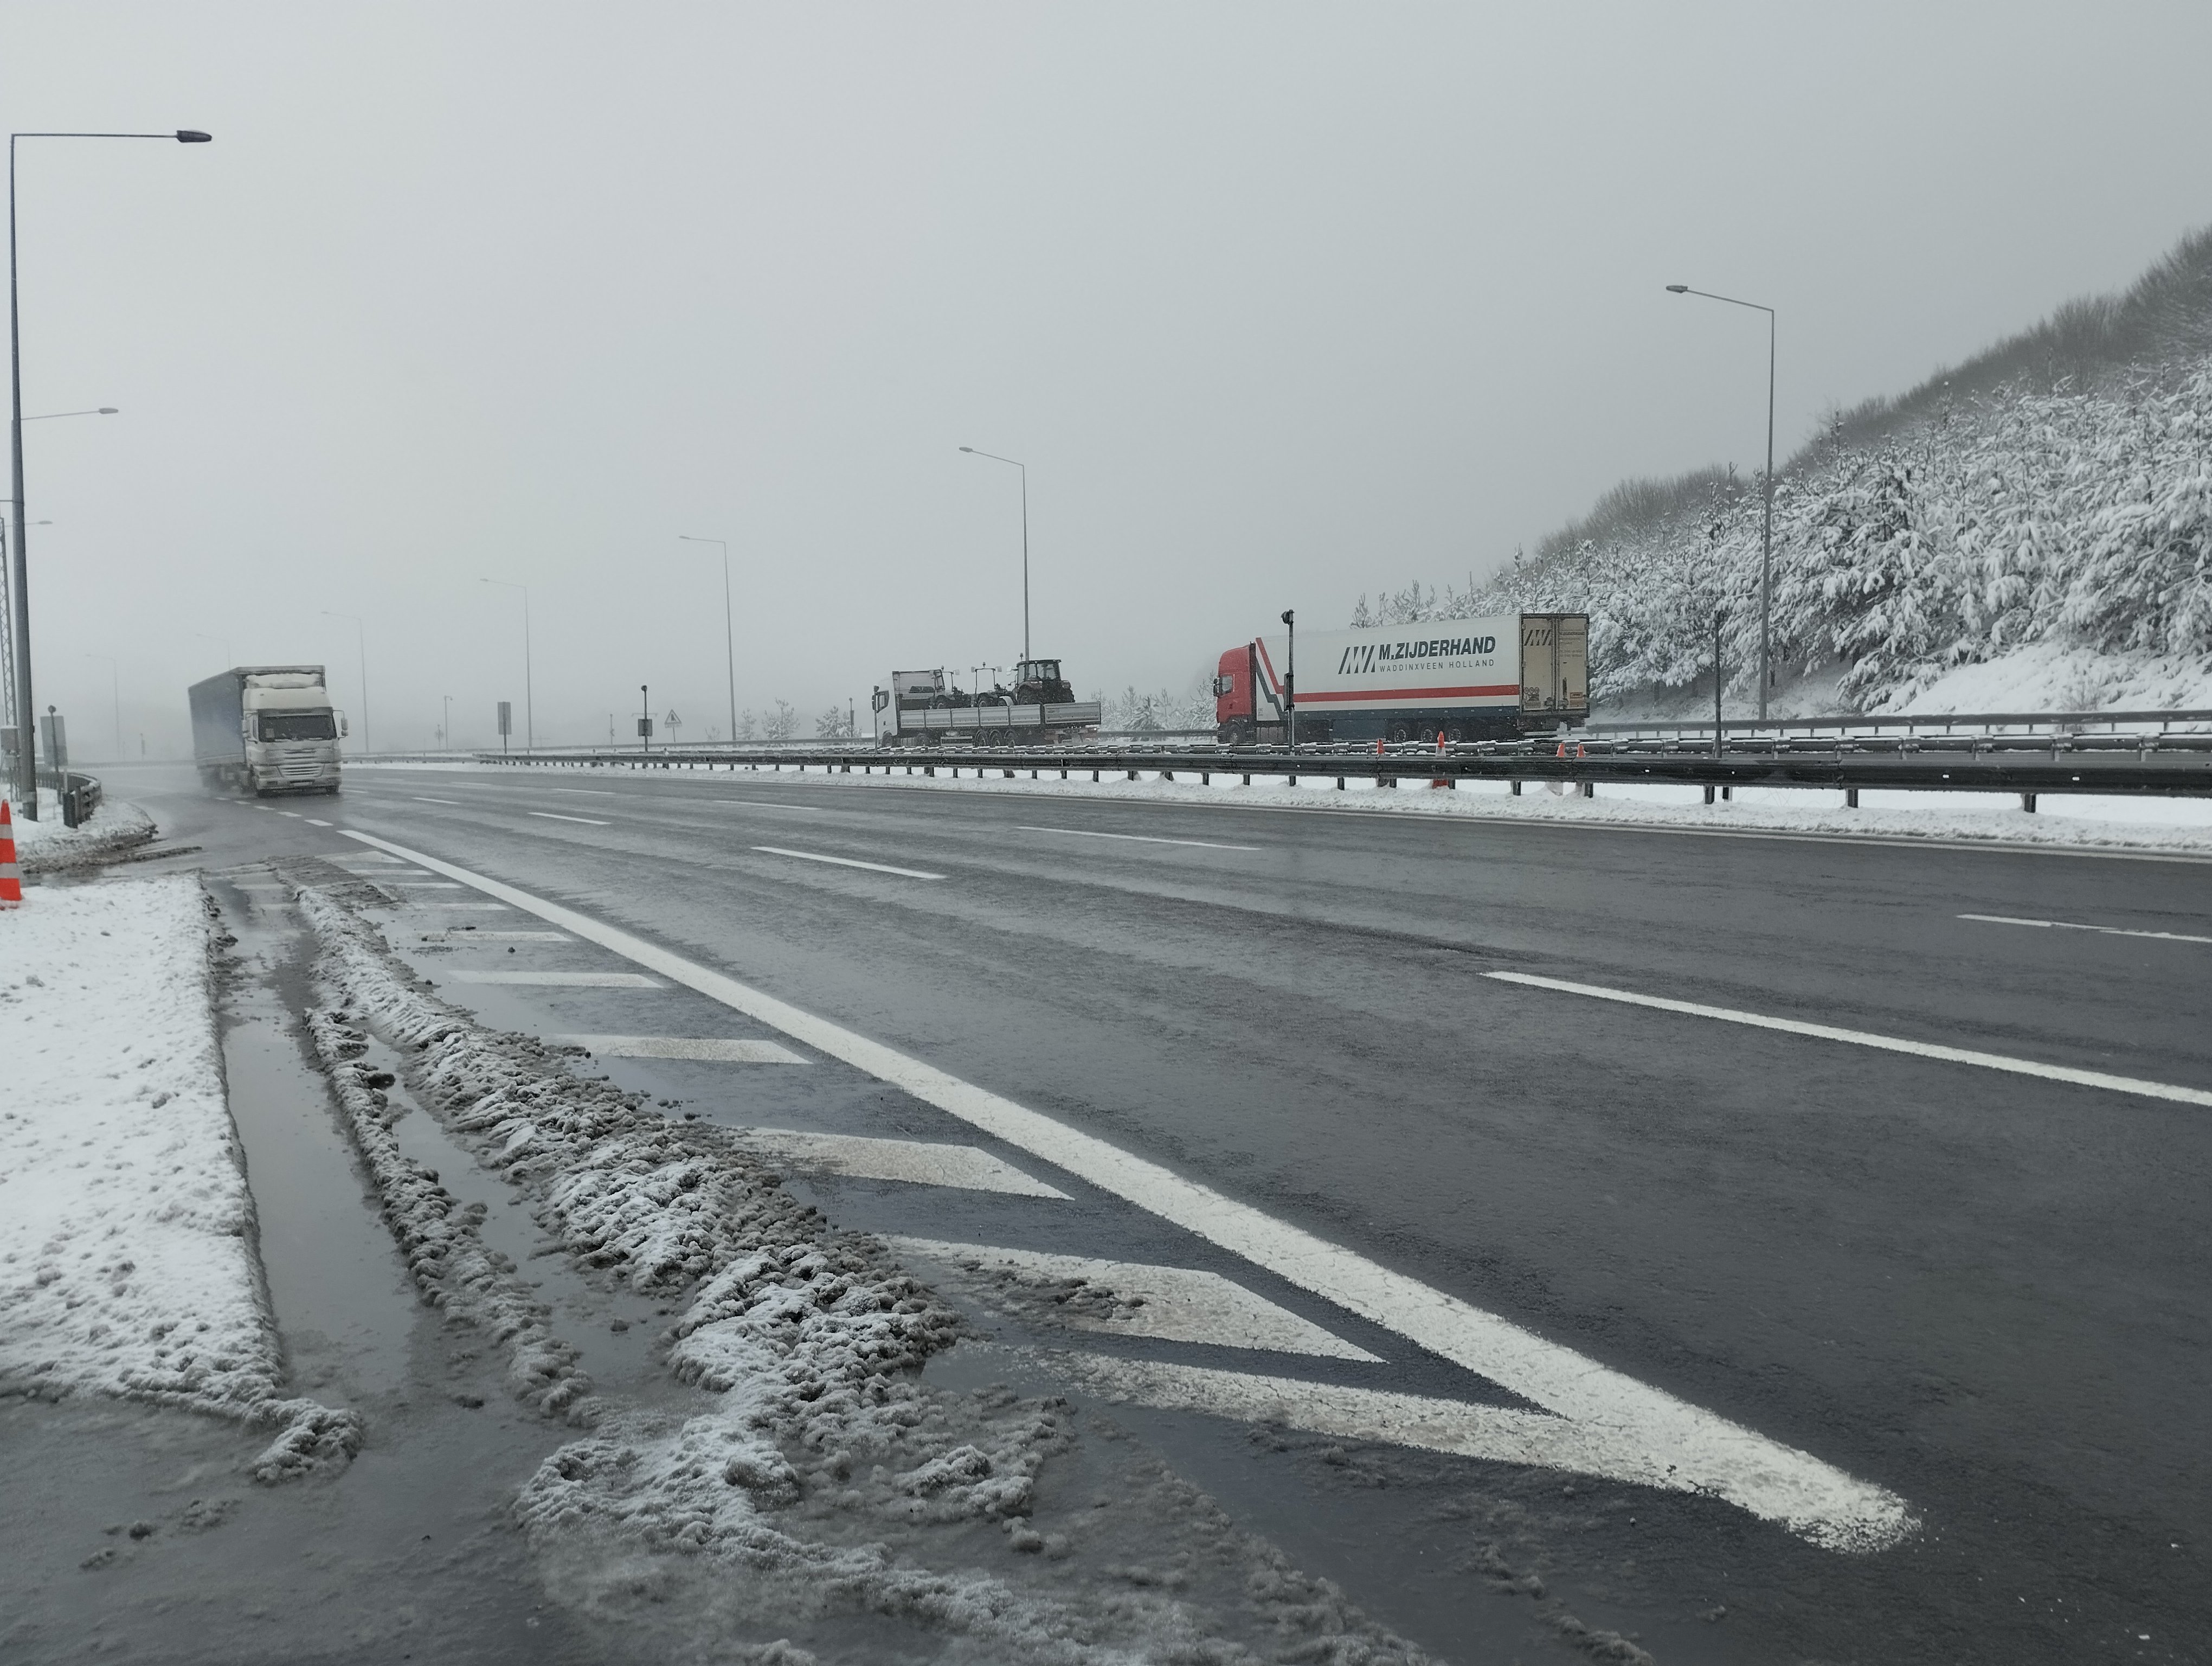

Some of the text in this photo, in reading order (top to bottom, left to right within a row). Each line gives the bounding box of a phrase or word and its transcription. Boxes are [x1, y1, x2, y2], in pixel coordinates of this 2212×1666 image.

[1379, 636, 1496, 660] M.ZIJDERHAND
[1380, 659, 1494, 672] WADDINXVEEN HOLLAND
